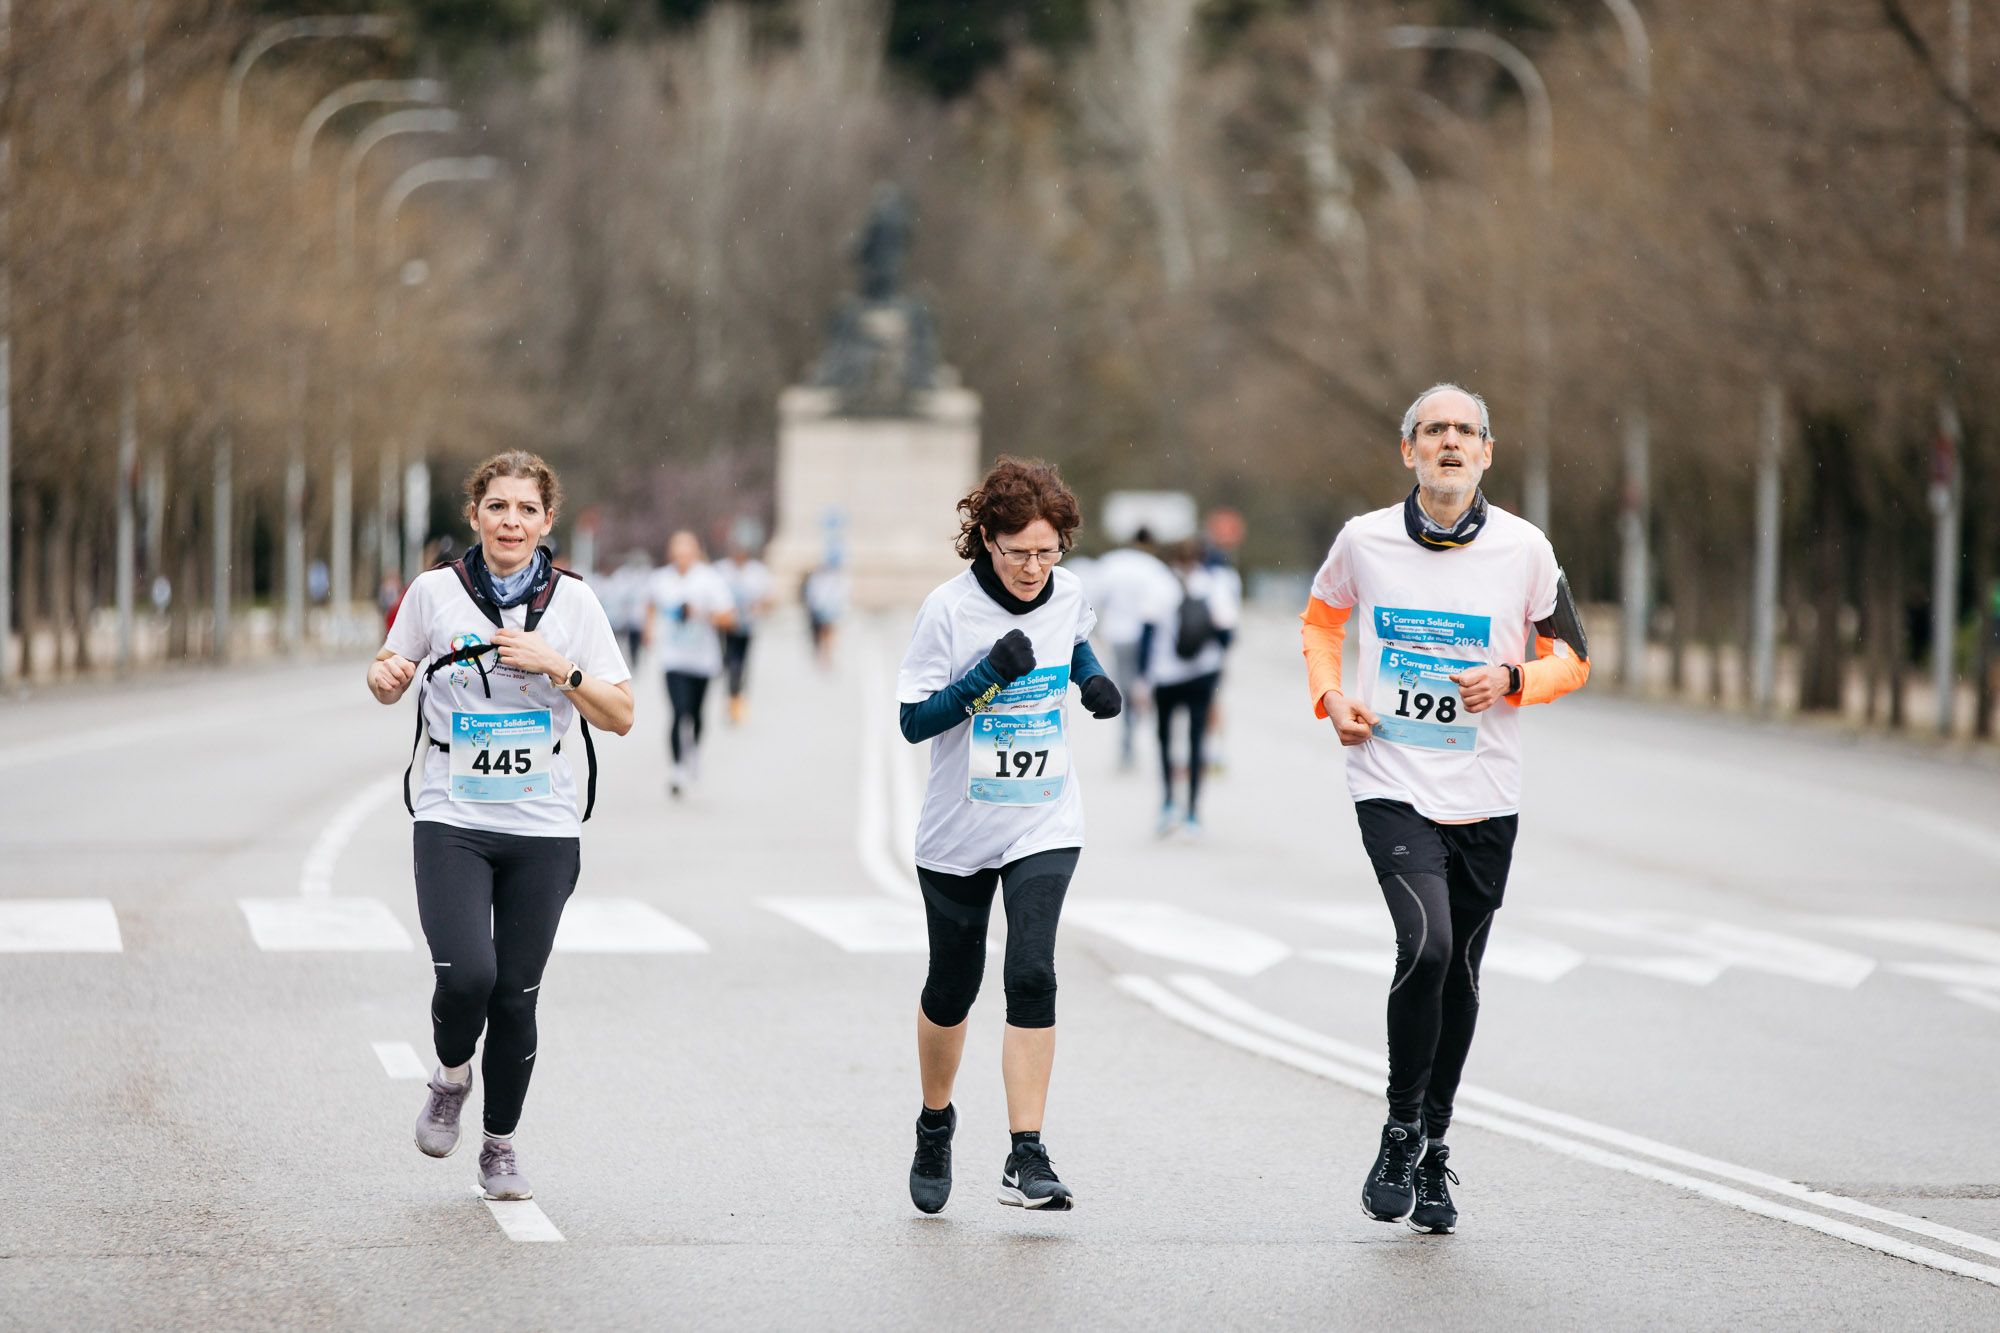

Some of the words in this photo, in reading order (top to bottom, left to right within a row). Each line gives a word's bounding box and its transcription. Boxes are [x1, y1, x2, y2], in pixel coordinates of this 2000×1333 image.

[1392, 615, 1425, 625] Carrera
[1427, 617, 1465, 629] Solidaria
[1454, 637, 1484, 648] 2026
[1400, 658, 1432, 670] Carrera
[1433, 663, 1465, 675] Solidari
[1027, 674, 1057, 685] Solidaria
[1395, 689, 1457, 723] 198
[471, 720, 502, 728] Carrera
[503, 717, 536, 728] Solidaria
[995, 720, 1026, 729] Carrera
[471, 748, 532, 775] 445
[995, 749, 1049, 778] 197
